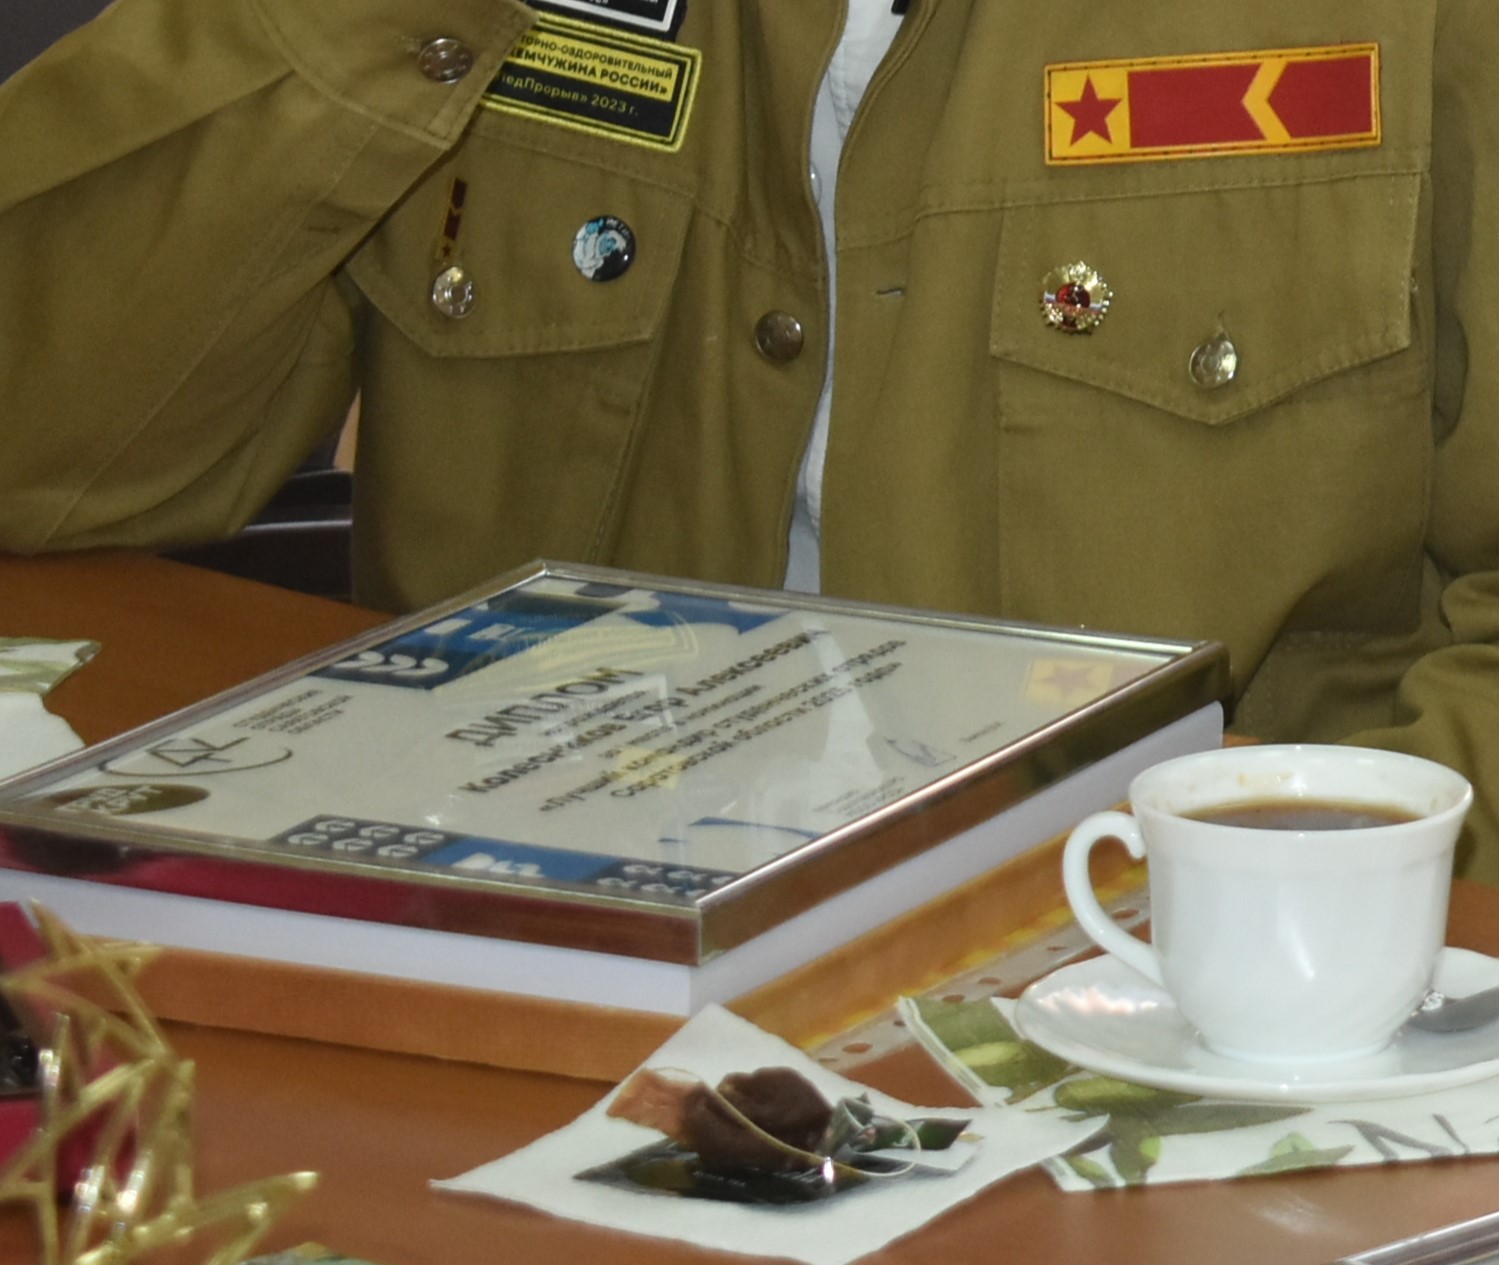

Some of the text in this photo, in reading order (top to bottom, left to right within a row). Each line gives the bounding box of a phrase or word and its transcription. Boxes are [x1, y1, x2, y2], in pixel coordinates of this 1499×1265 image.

[599, 64, 669, 96] РОССИИ»
[590, 92, 628, 114] 2023
[629, 103, 639, 117] г.
[446, 667, 642, 746] ДИПЛОМ
